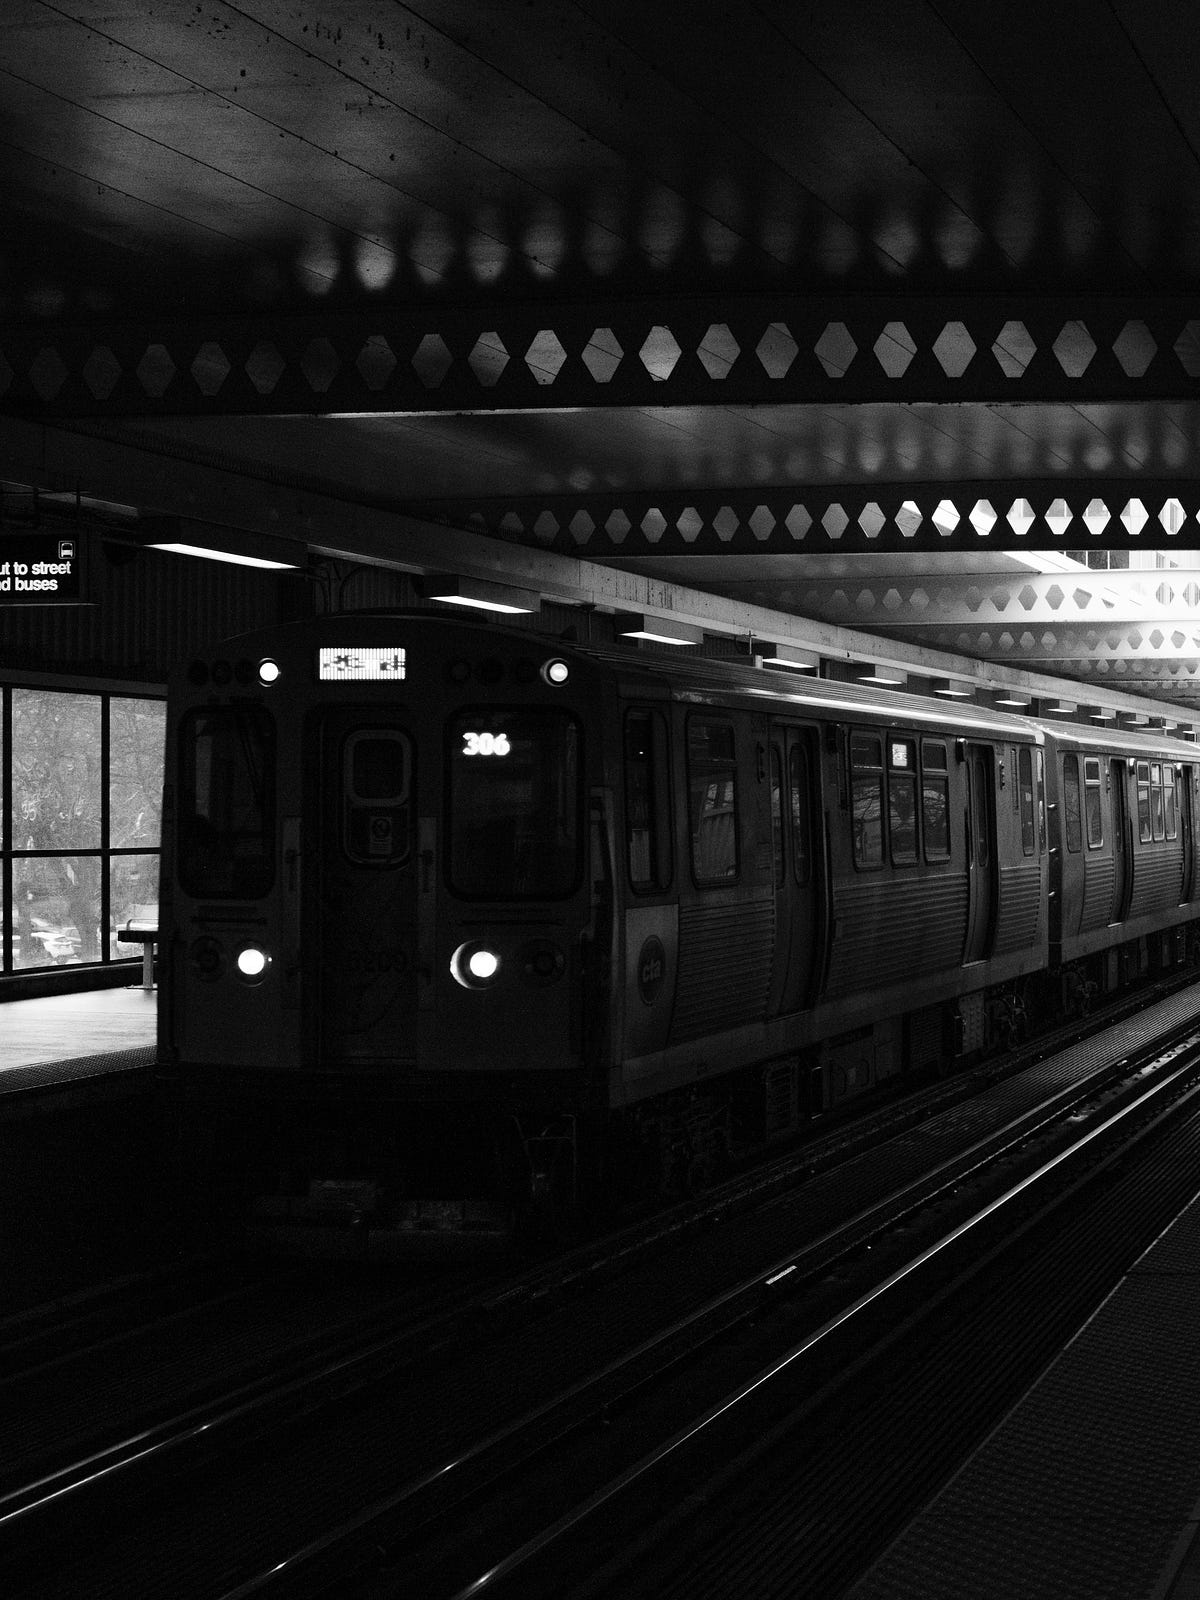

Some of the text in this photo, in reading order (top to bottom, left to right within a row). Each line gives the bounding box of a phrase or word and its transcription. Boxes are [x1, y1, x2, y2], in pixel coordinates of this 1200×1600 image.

[0, 561, 71, 575] ut to street
[15, 577, 58, 591] buses
[462, 732, 511, 756] 306
[642, 958, 661, 983] cta
